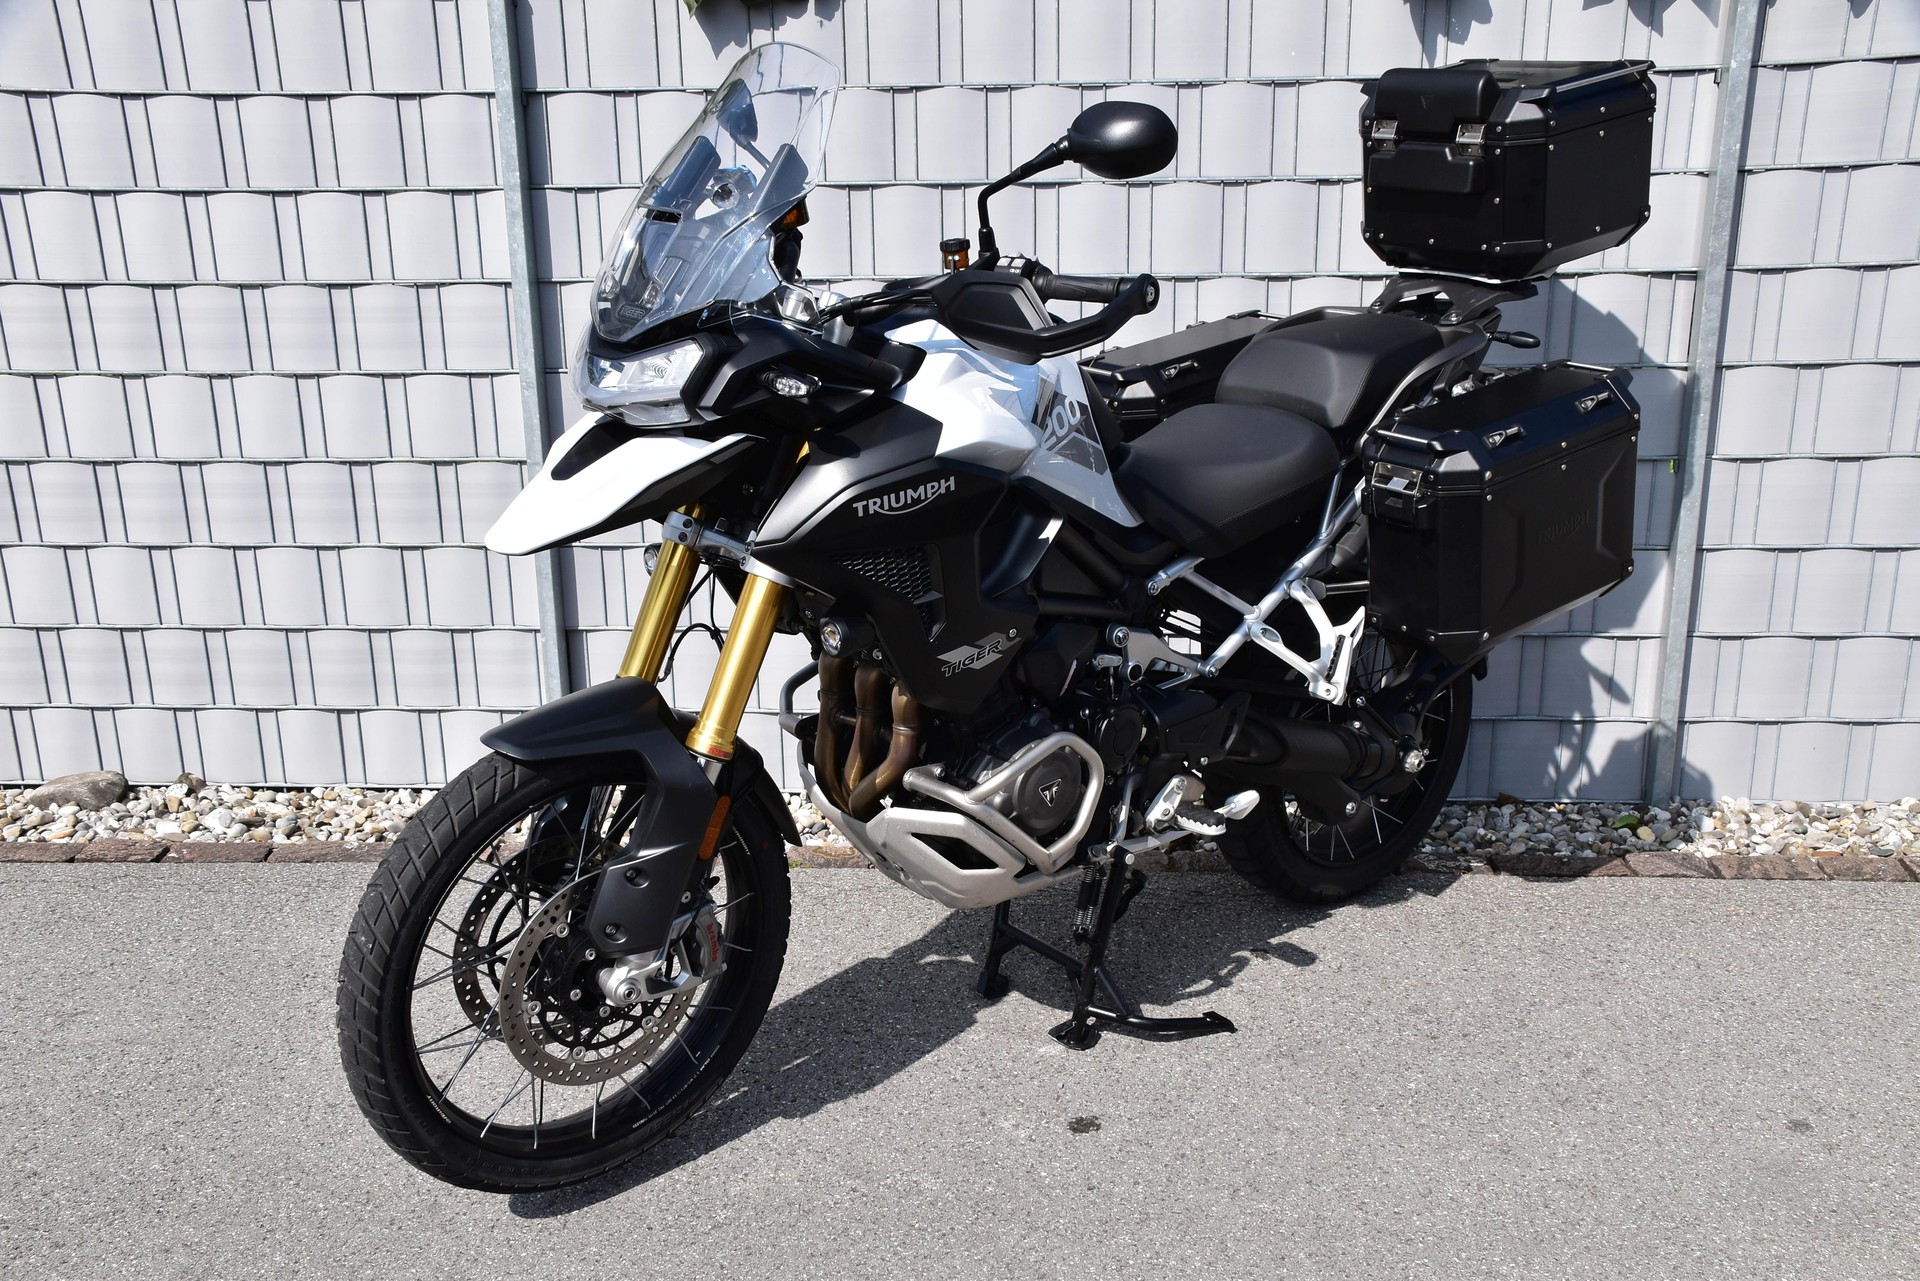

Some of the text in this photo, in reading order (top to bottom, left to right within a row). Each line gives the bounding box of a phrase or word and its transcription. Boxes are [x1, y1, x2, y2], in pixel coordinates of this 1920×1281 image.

[852, 475, 956, 518] TRIUMPH
[941, 638, 1002, 678] TIGER
[706, 922, 719, 962] brembo
